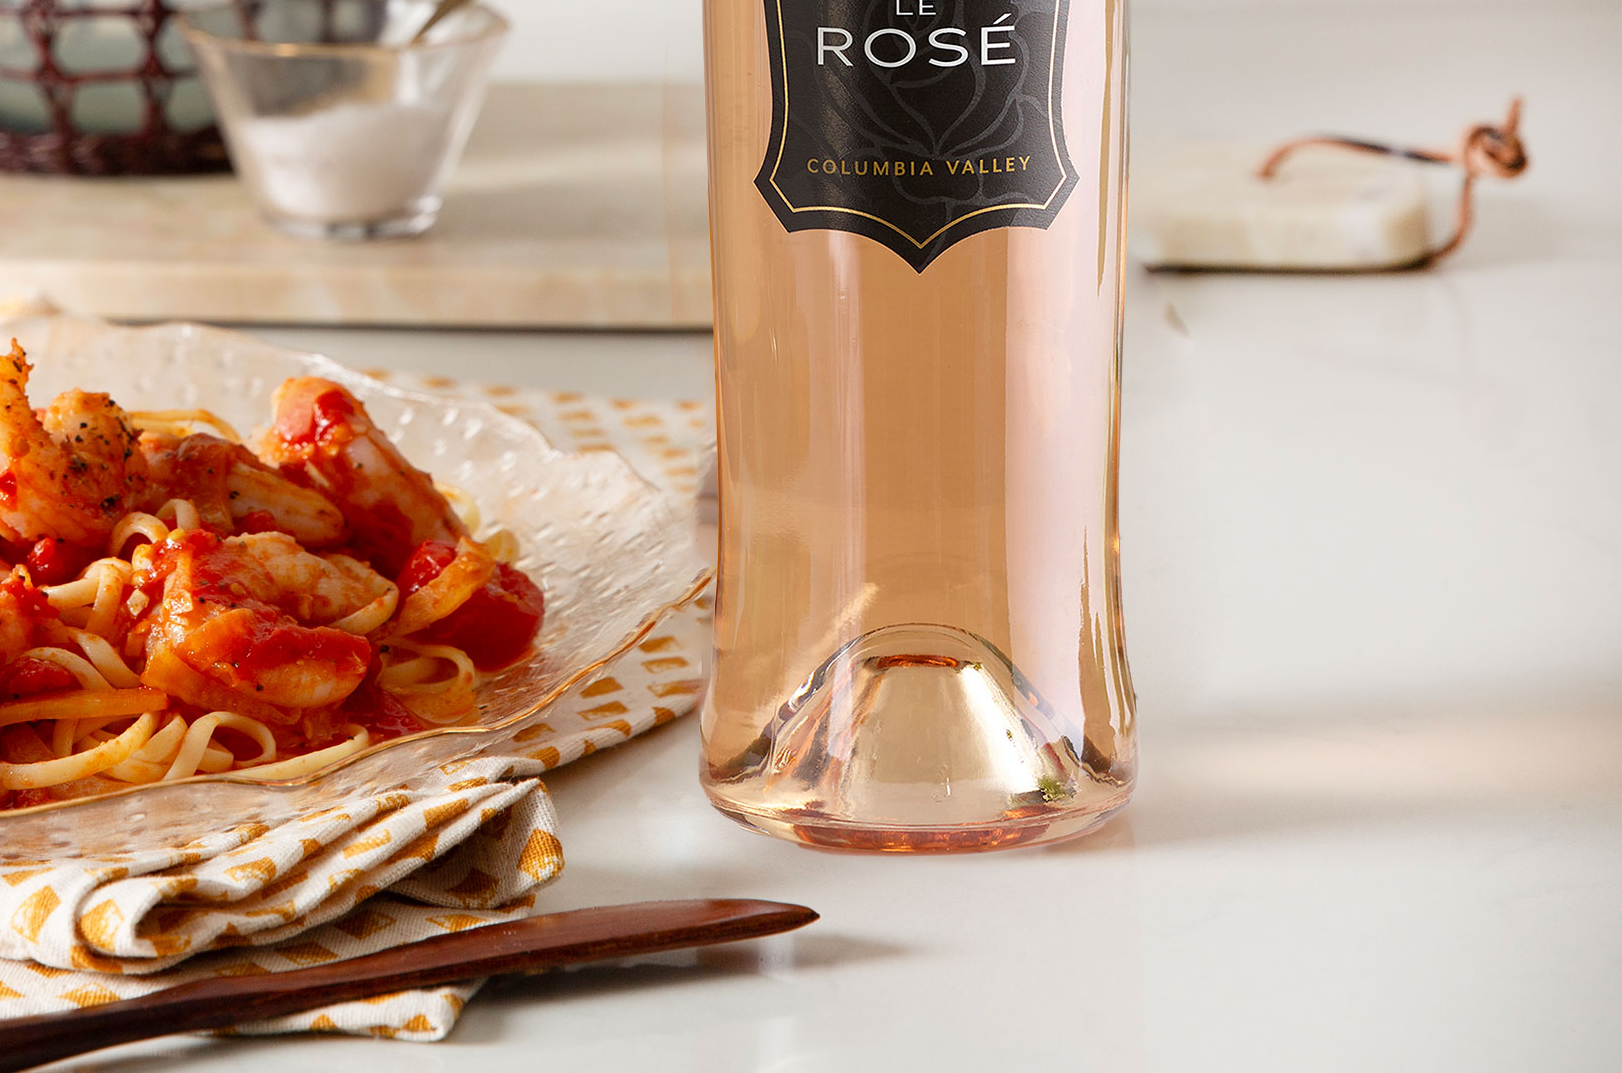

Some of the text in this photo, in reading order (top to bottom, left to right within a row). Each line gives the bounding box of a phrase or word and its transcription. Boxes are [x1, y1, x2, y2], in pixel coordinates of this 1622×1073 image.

[817, 13, 1016, 67] ROSÉ
[807, 155, 1031, 177] COLUMBIA VALLEY
